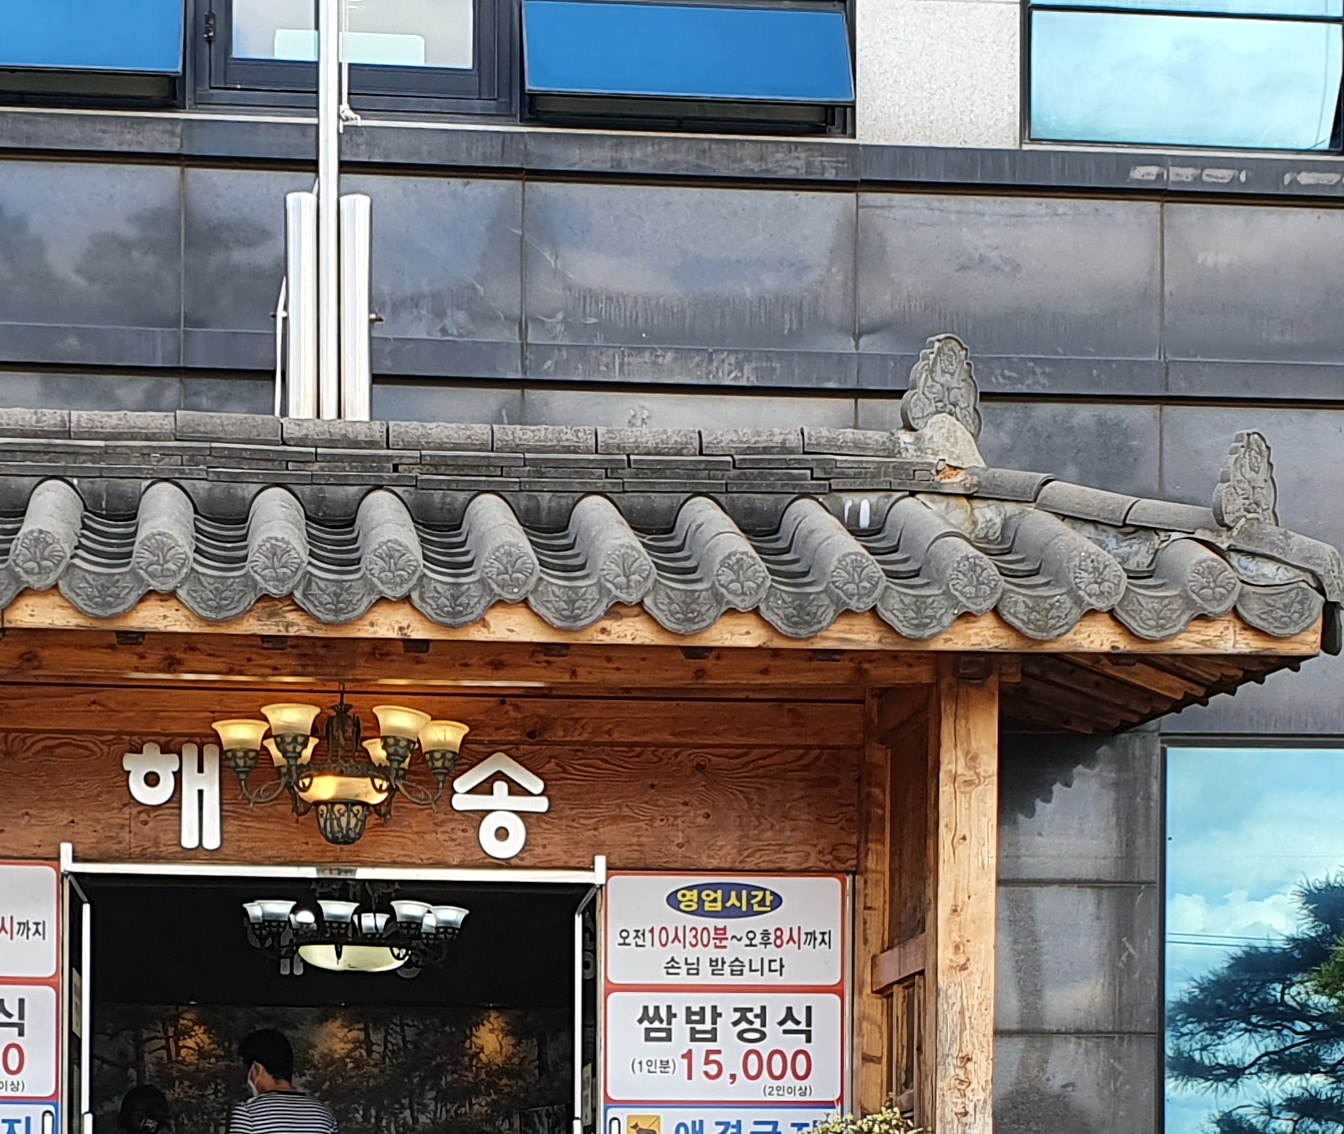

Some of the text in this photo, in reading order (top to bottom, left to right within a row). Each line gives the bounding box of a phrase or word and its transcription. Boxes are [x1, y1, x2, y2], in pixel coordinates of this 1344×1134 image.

[676, 888, 774, 913] 영업시간
[616, 924, 832, 950] 오전10시30분~오후8시까지
[663, 956, 785, 978] 손님 받습니다
[636, 1003, 814, 1044] 쌈밥정식
[631, 1049, 813, 1085] (1인분) 15,000
[762, 1085, 813, 1098] (2인이상)
